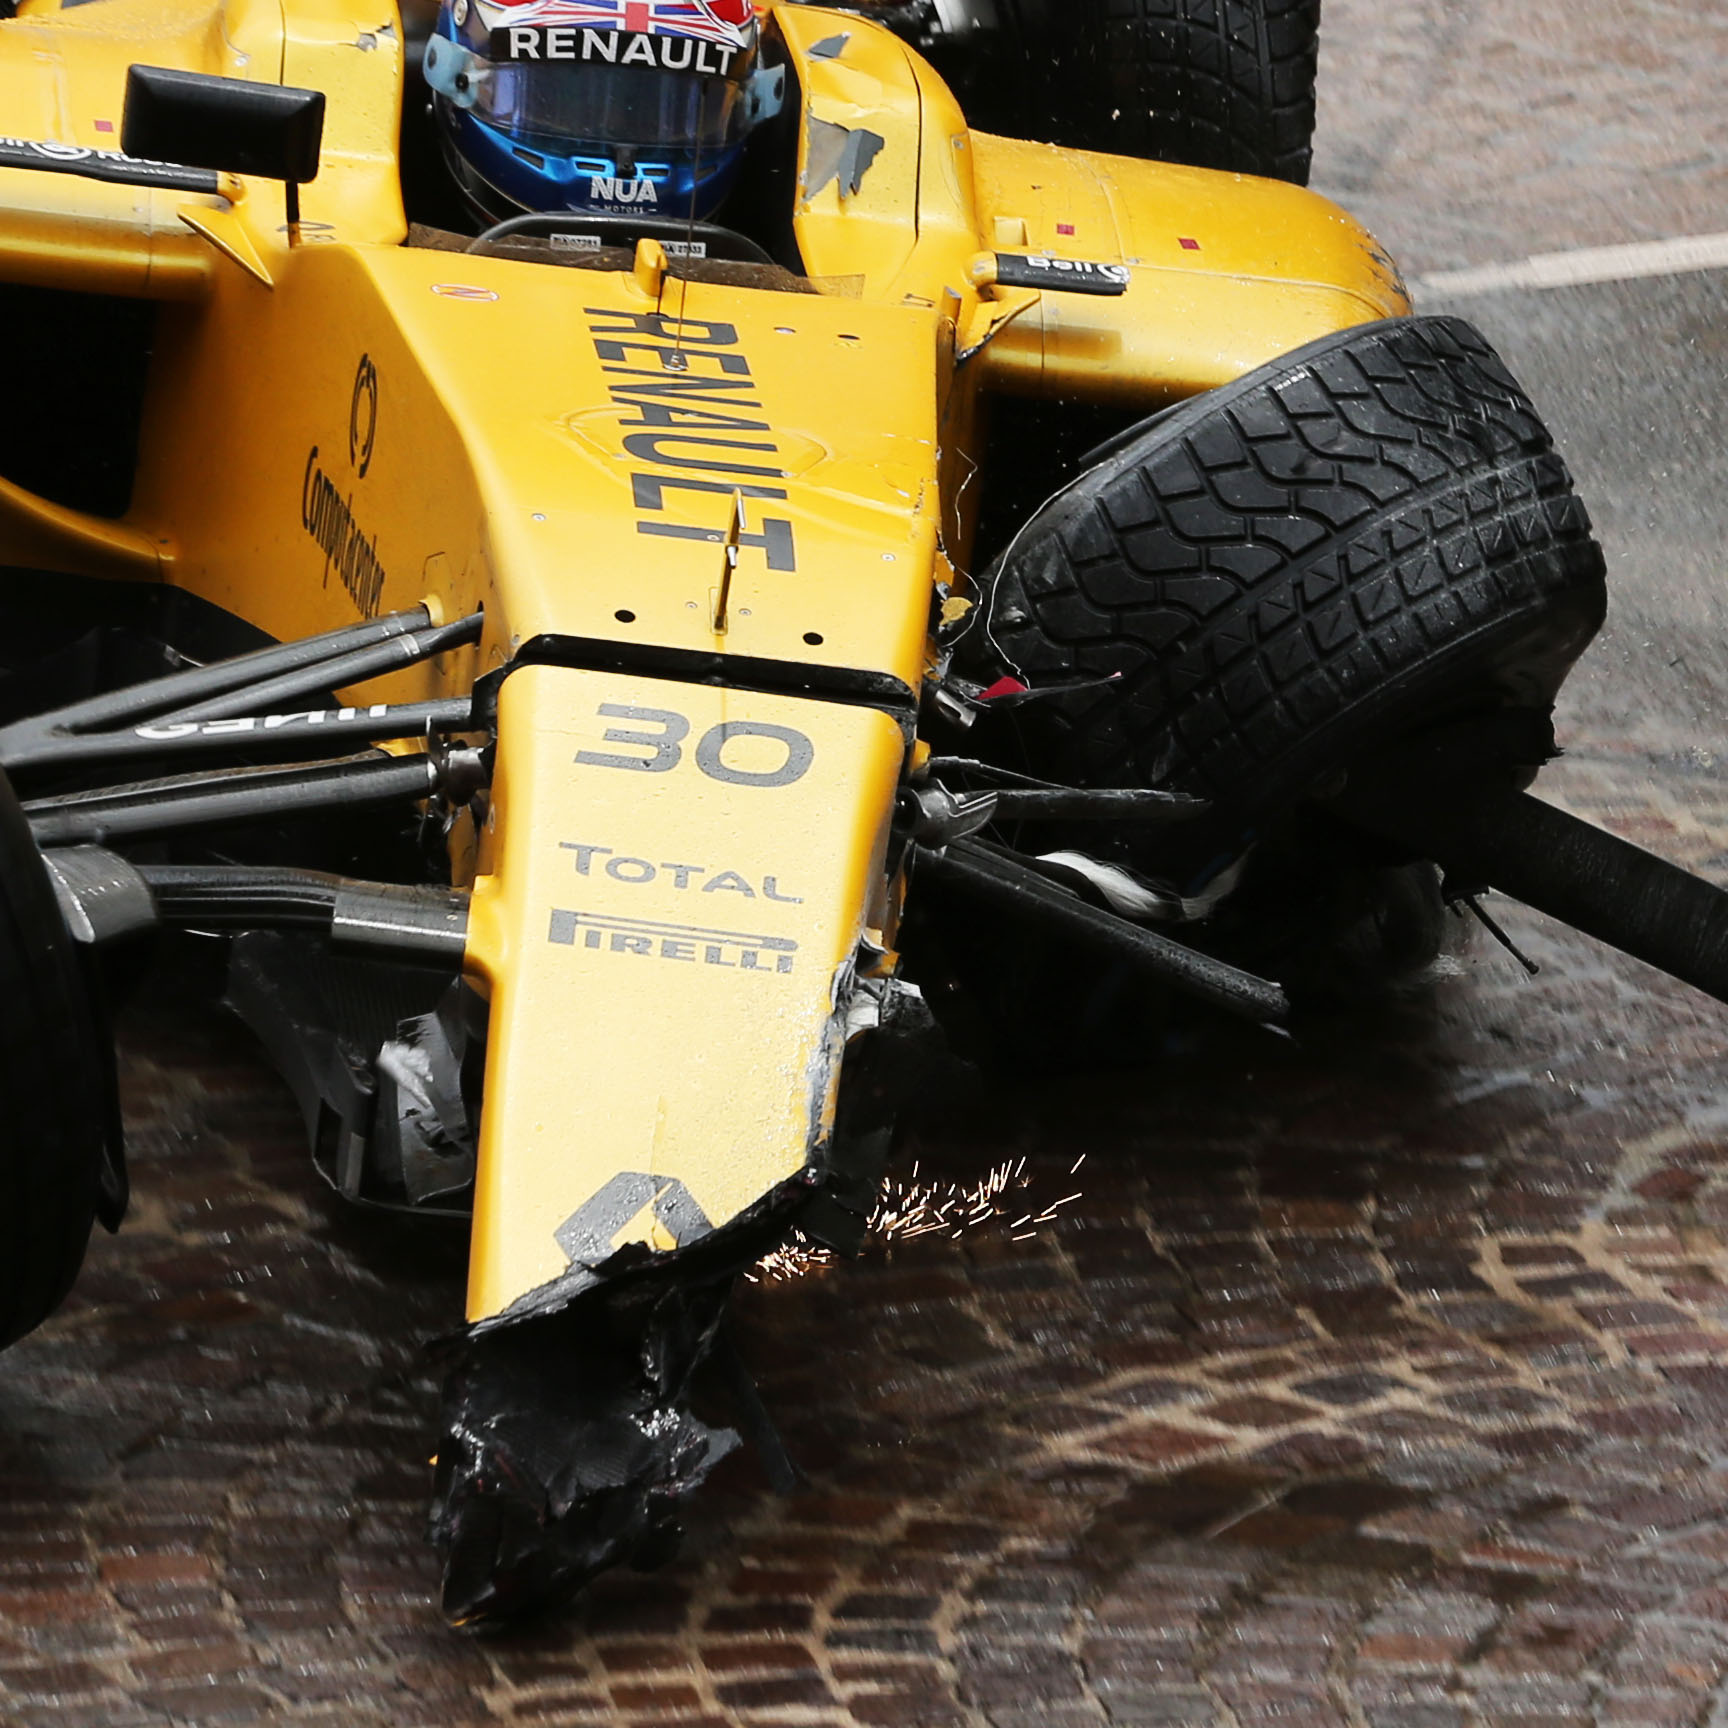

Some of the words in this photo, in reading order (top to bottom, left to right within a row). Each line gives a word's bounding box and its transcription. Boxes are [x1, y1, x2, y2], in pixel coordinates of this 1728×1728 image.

[509, 27, 738, 76] RENAULT
[590, 175, 658, 203] NUA
[582, 307, 797, 573] RENAULT
[573, 702, 815, 788] 30
[558, 841, 805, 904] TOTAL
[547, 908, 799, 974] PIRELLI
